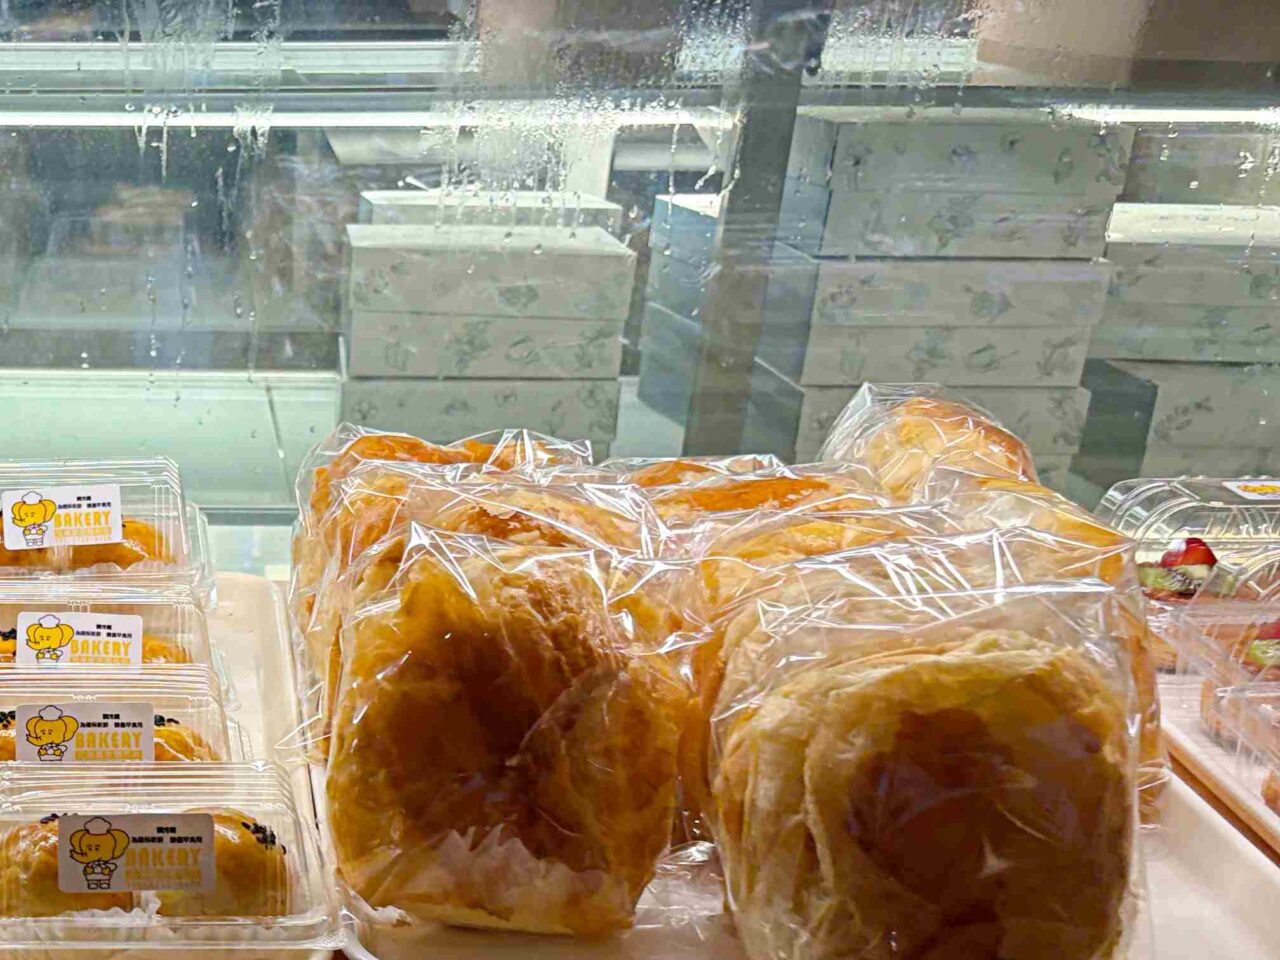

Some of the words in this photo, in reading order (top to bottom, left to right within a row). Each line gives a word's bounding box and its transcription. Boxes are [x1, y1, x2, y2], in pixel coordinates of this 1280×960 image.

[54, 511, 111, 528] BAKERY
[71, 640, 131, 656] BAKERY
[76, 732, 142, 748] BAKERY
[125, 848, 201, 866] BAKERY
